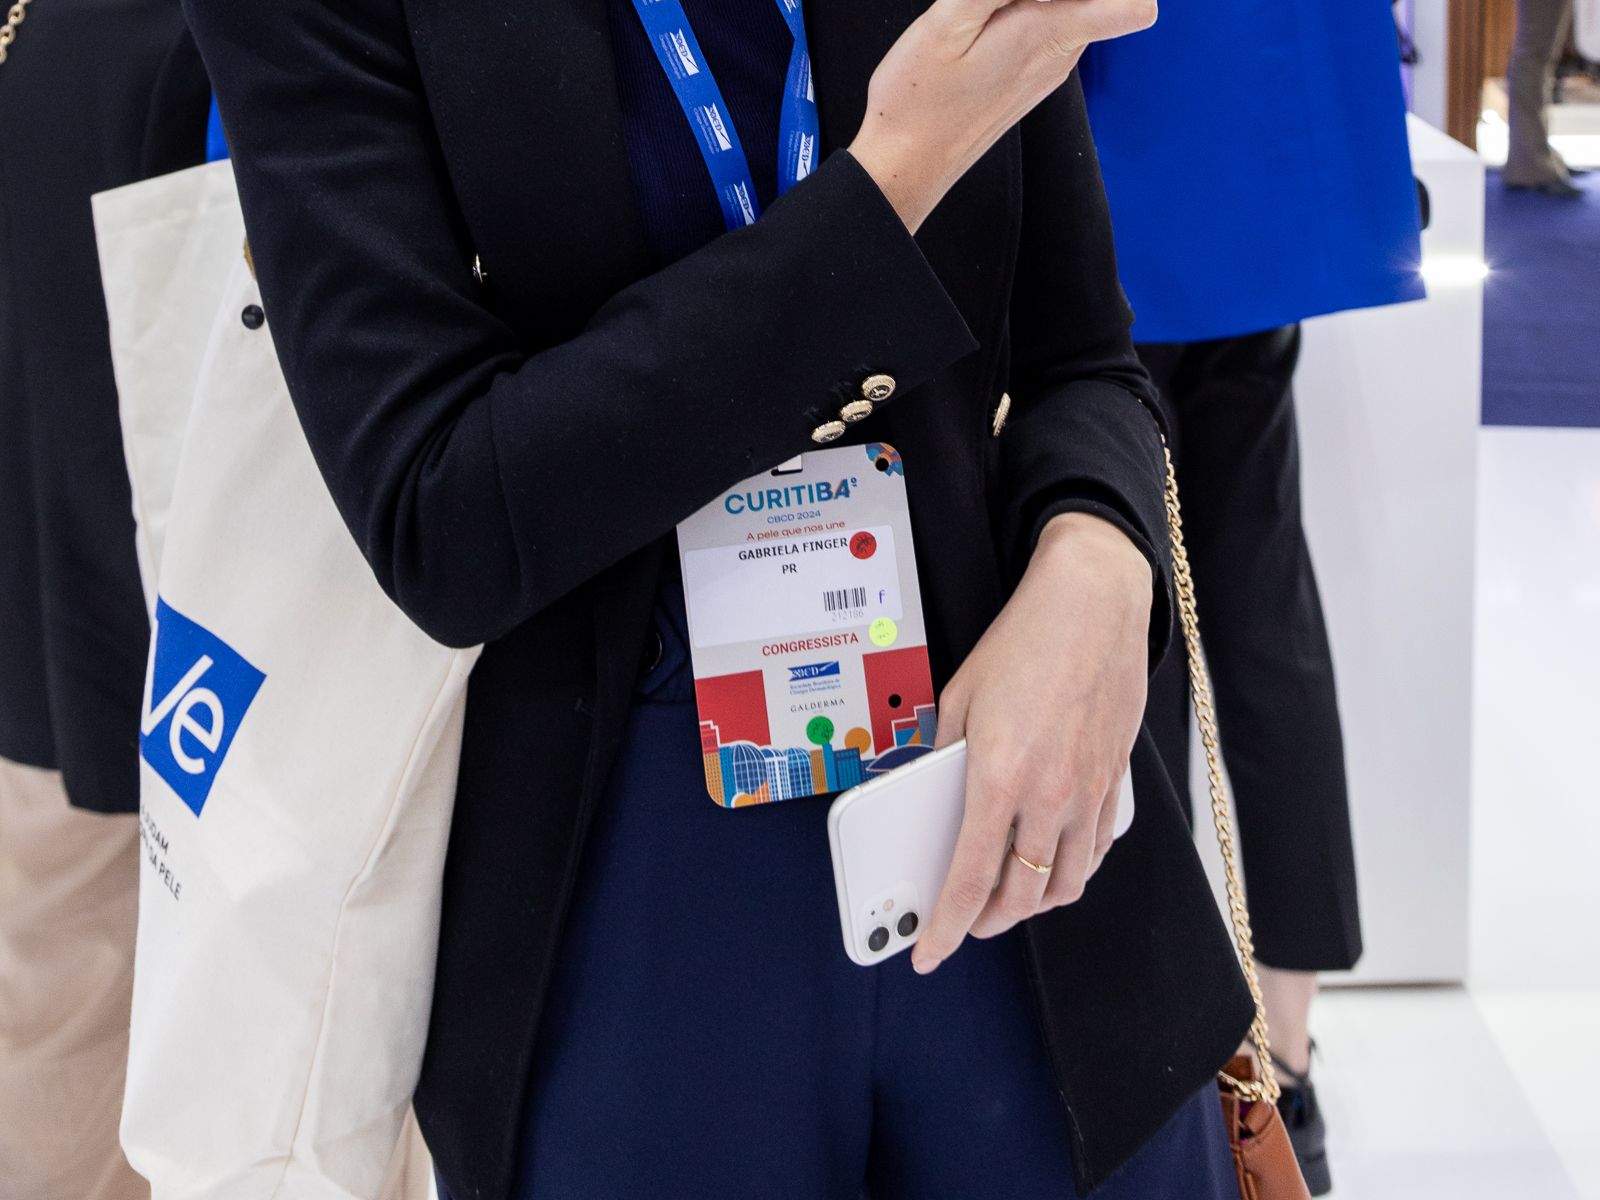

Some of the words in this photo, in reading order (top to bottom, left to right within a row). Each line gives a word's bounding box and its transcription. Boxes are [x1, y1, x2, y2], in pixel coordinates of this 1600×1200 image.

[767, 514, 795, 524] CBCD
[796, 510, 821, 520] 2024
[746, 532, 755, 541] A
[757, 530, 779, 541] pele
[781, 526, 801, 538] que
[804, 524, 823, 533] nos
[825, 520, 845, 530] une
[738, 543, 799, 561] GABRIELA
[802, 537, 848, 553] FINGER
[782, 563, 797, 575] PR
[762, 632, 859, 656] CONGRESSISTA
[790, 698, 845, 713] GALDERMA
[159, 860, 182, 902] PELE
